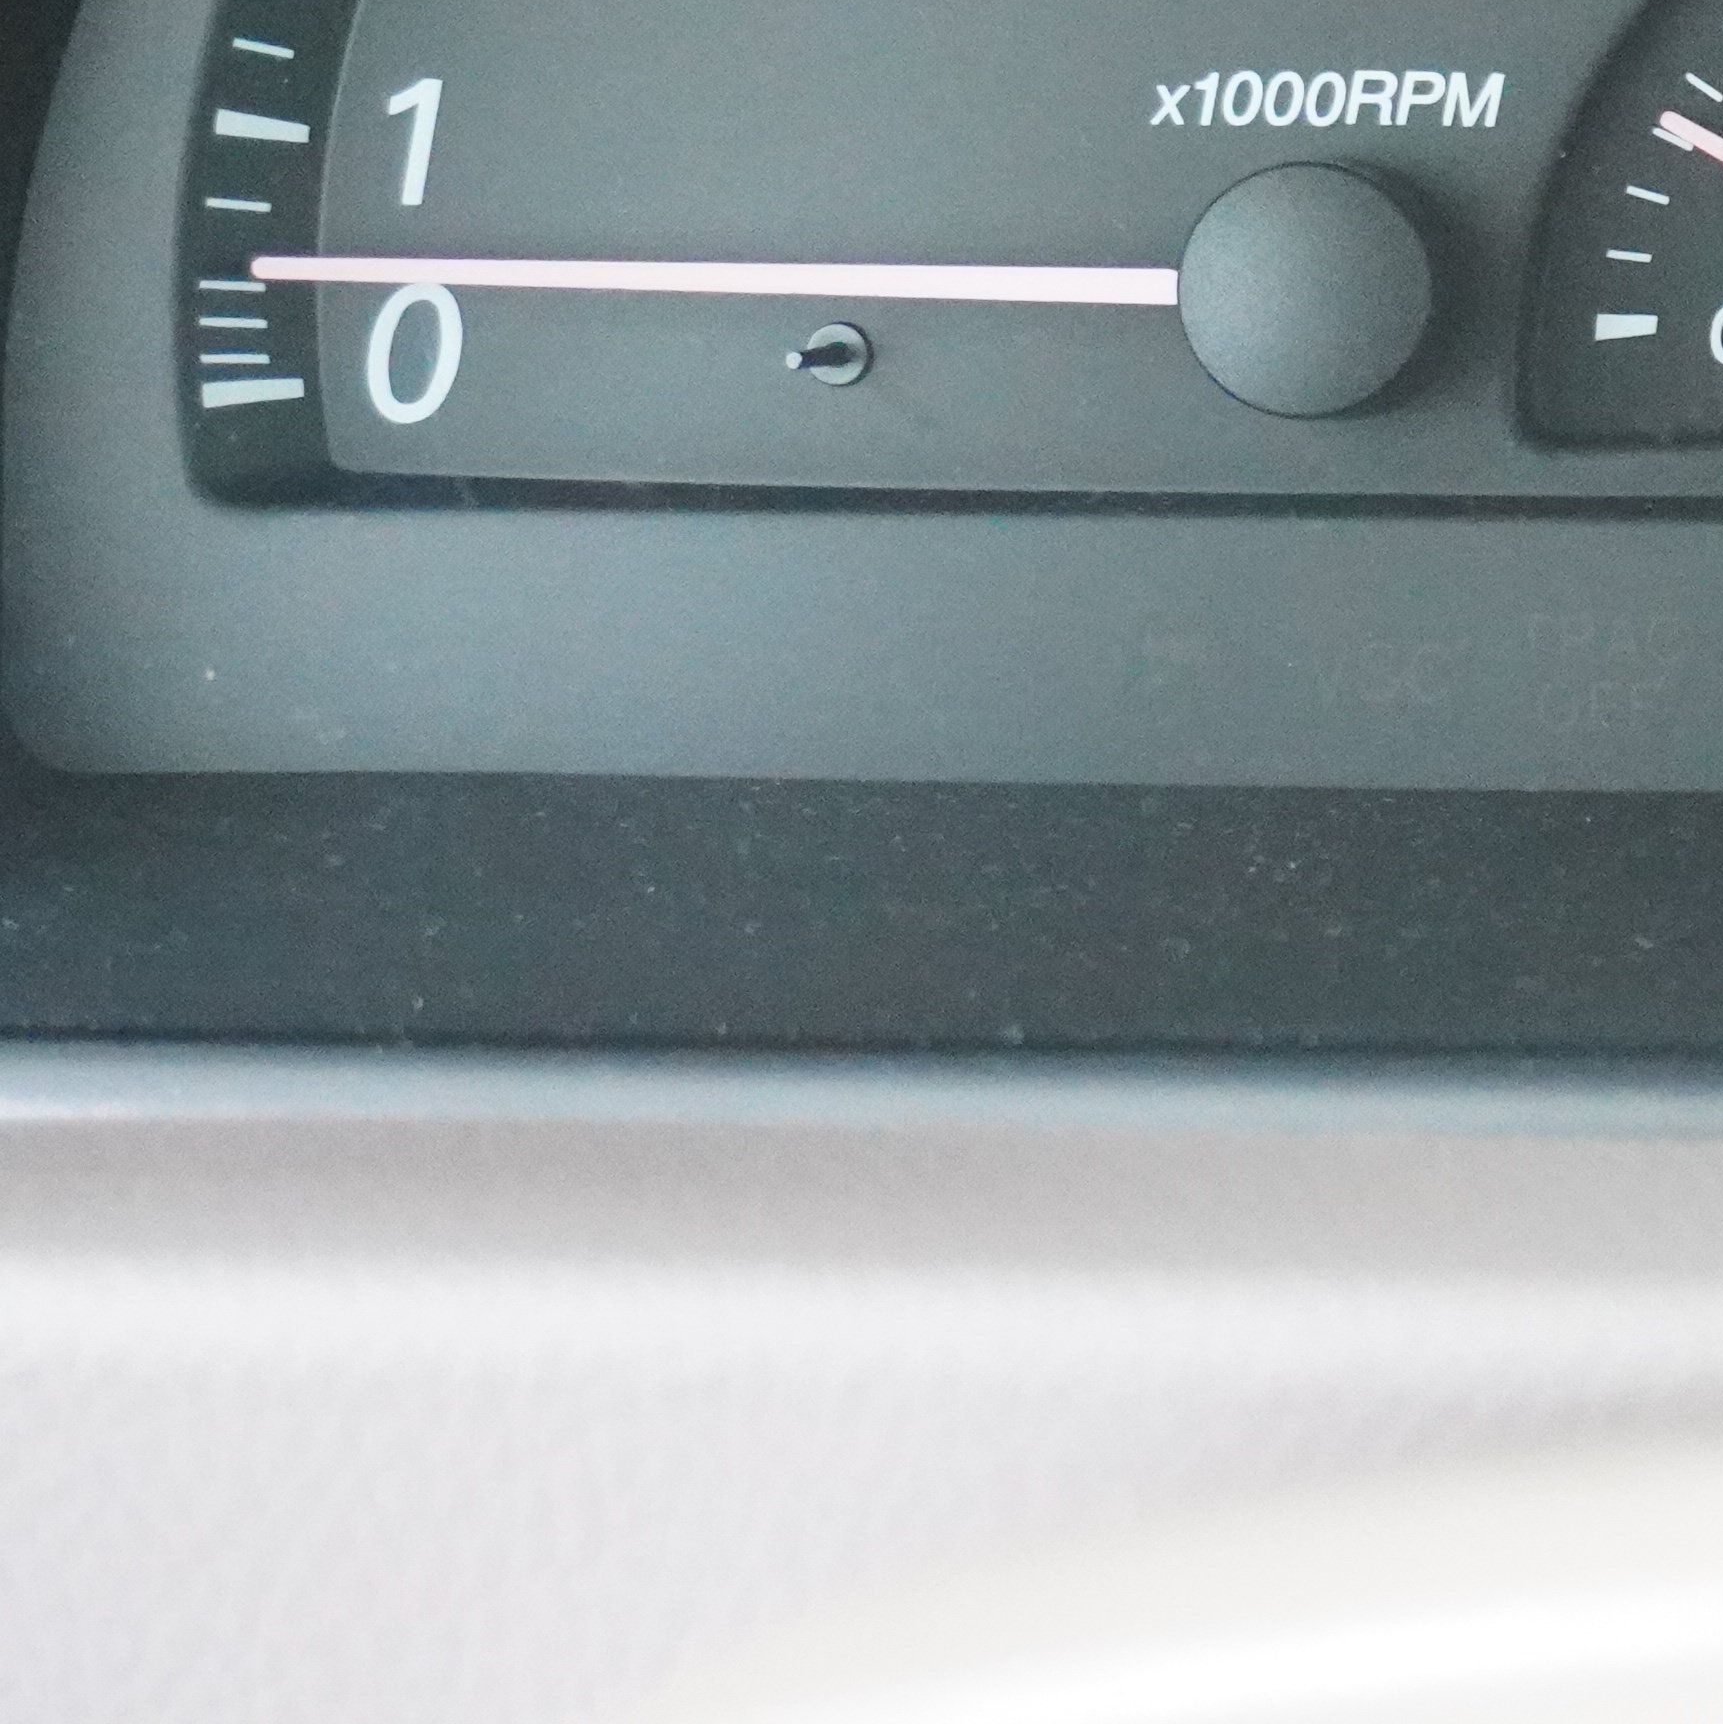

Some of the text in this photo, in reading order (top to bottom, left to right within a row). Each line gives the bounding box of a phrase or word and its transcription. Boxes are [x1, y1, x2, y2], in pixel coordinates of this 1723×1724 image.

[388, 79, 442, 205] 1
[1150, 70, 1505, 127] x1000RPM
[366, 282, 463, 424] 0
